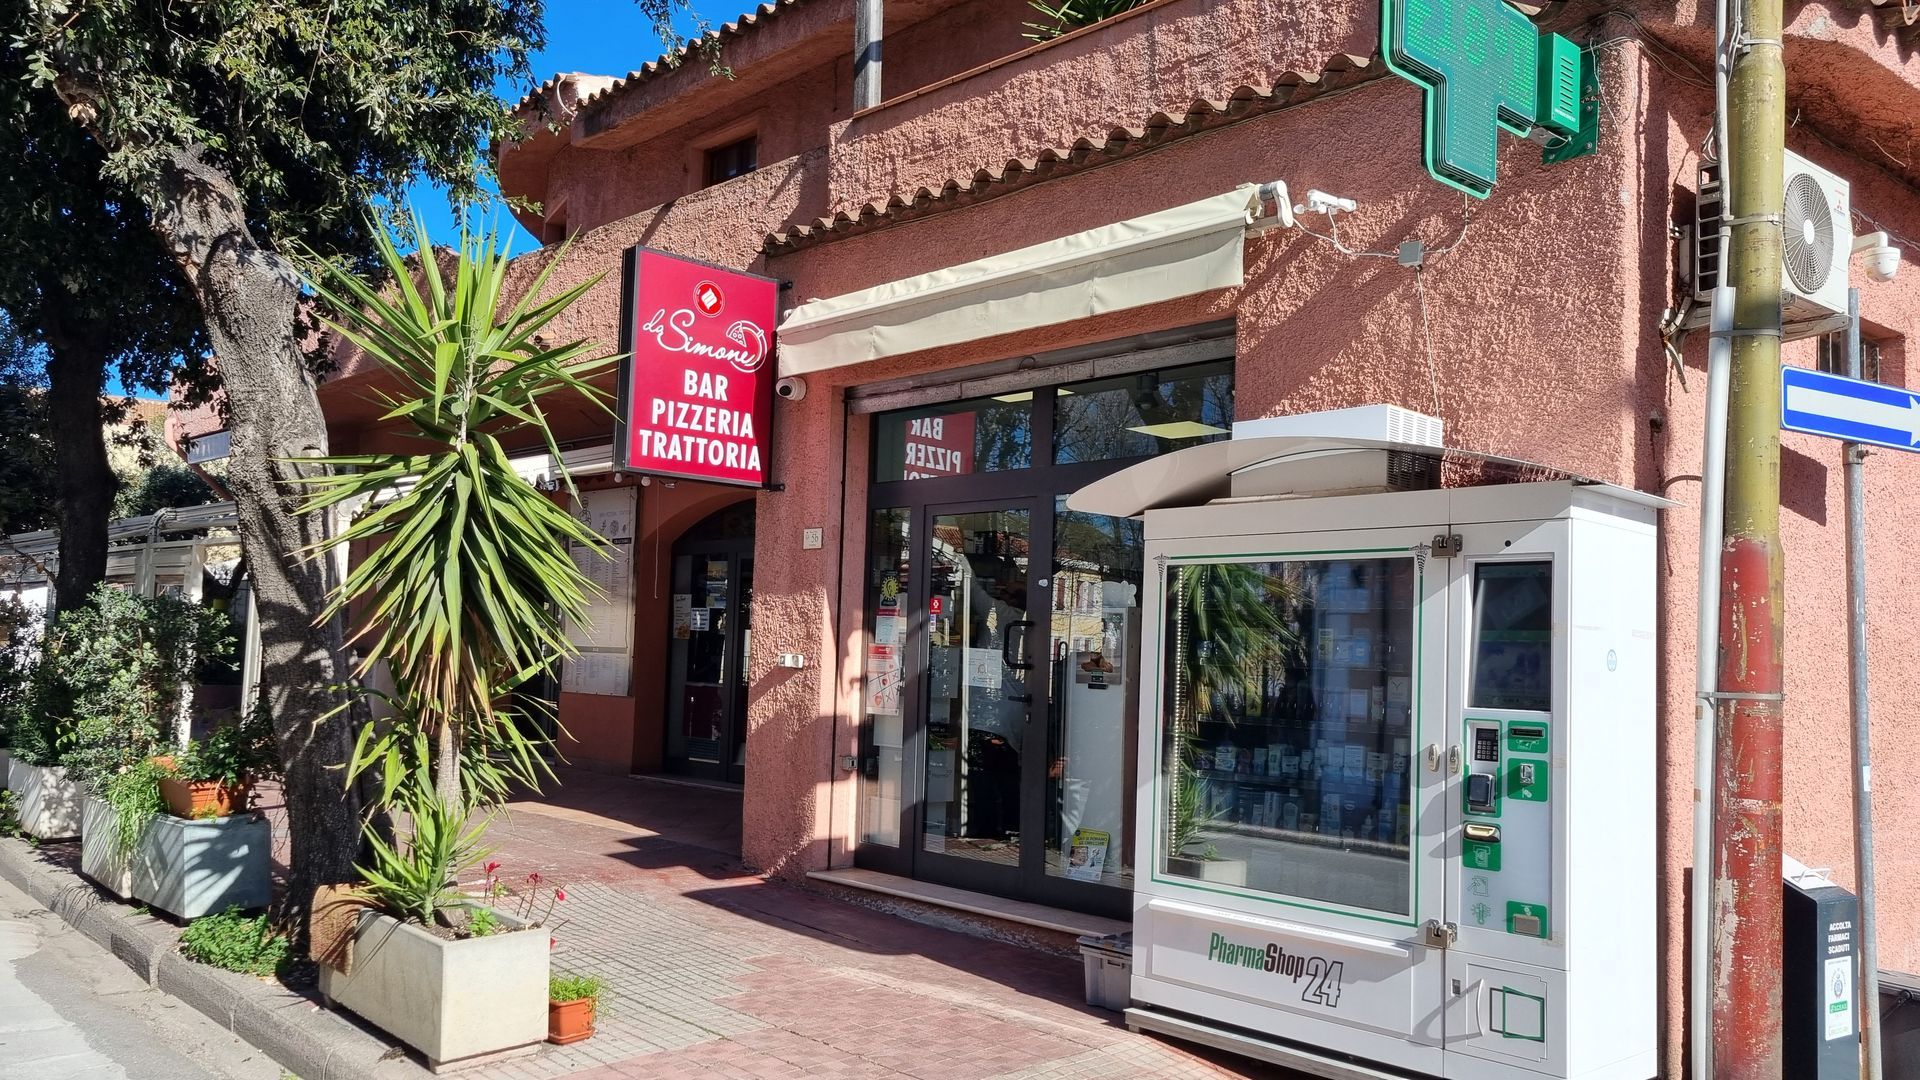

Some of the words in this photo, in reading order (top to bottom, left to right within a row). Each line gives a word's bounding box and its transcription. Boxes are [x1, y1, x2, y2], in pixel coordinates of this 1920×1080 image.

[643, 308, 665, 336] da
[657, 309, 756, 366] Simone
[684, 369, 729, 402] BAR
[651, 398, 754, 439] PIZZERIA
[639, 429, 761, 472] TRATTORIA
[1828, 932, 1850, 943] FARMACI
[1828, 943, 1850, 954] SCADUTI
[1301, 957, 1344, 1008] 24
